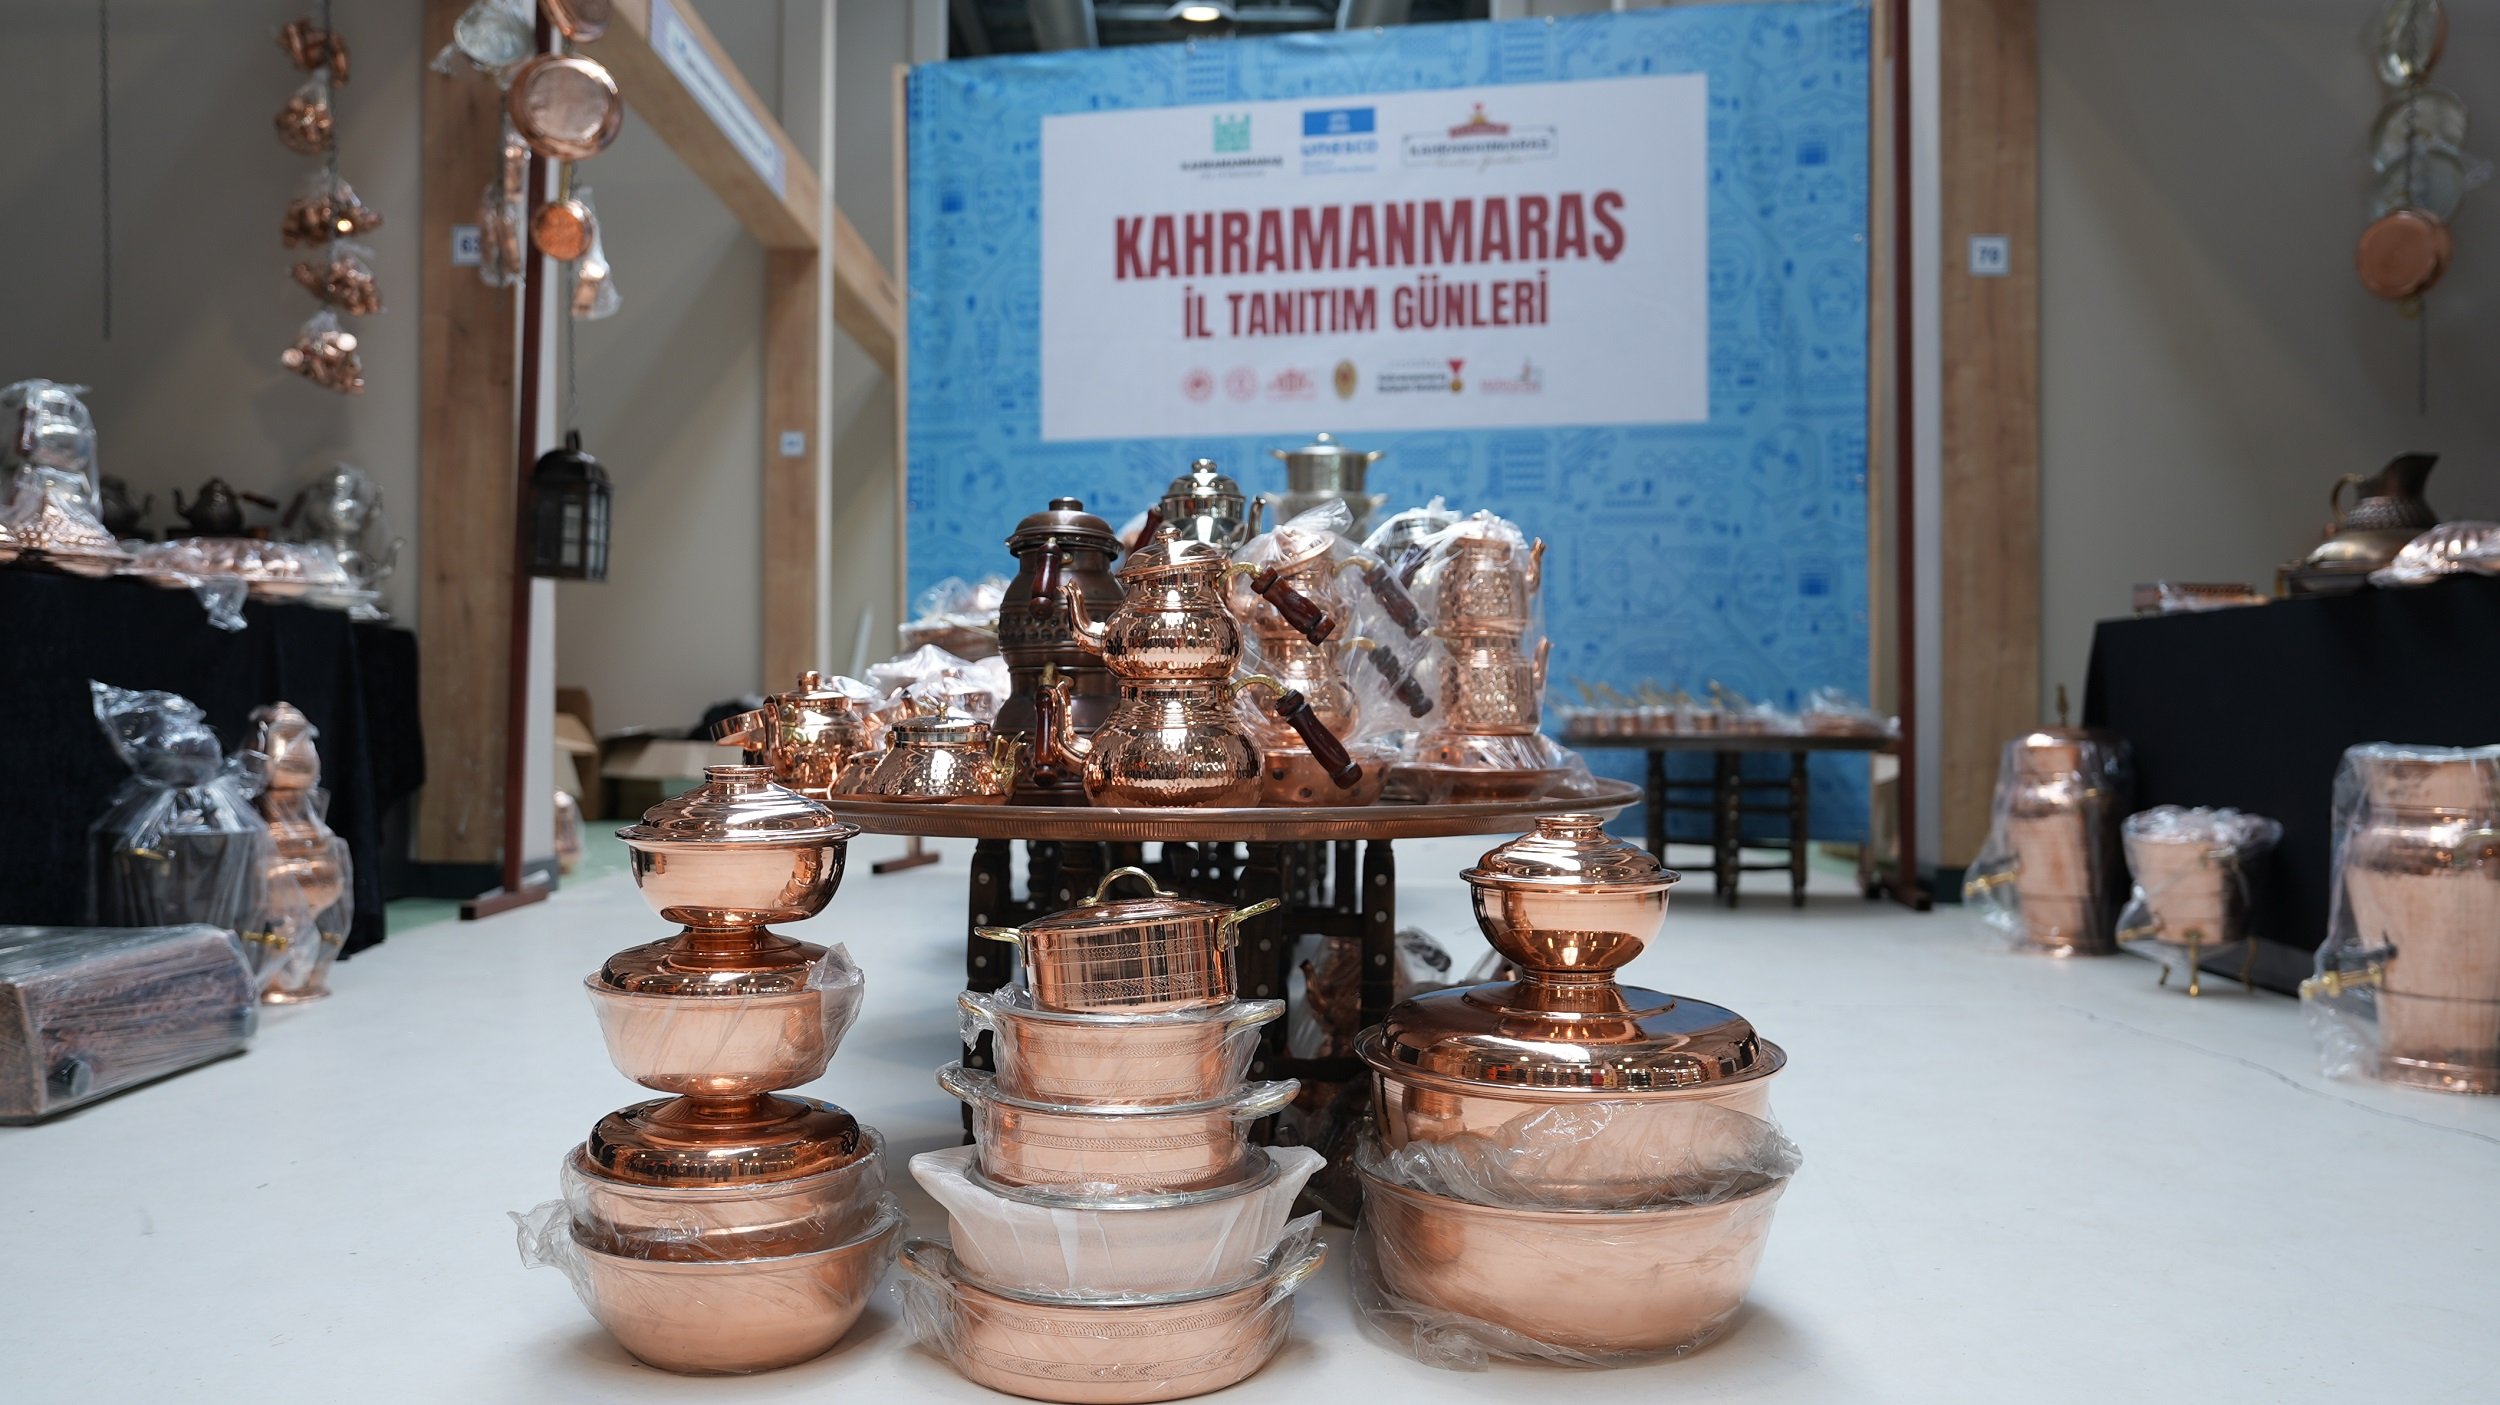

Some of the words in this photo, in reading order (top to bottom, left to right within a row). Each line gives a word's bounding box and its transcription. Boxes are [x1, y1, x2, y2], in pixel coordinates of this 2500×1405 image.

[1114, 191, 1626, 281] KAHRAMANMARAŞ
[1184, 286, 1212, 340] İL
[1227, 286, 1377, 337] TANITIM
[1393, 269, 1549, 330] GÜNLERİ
